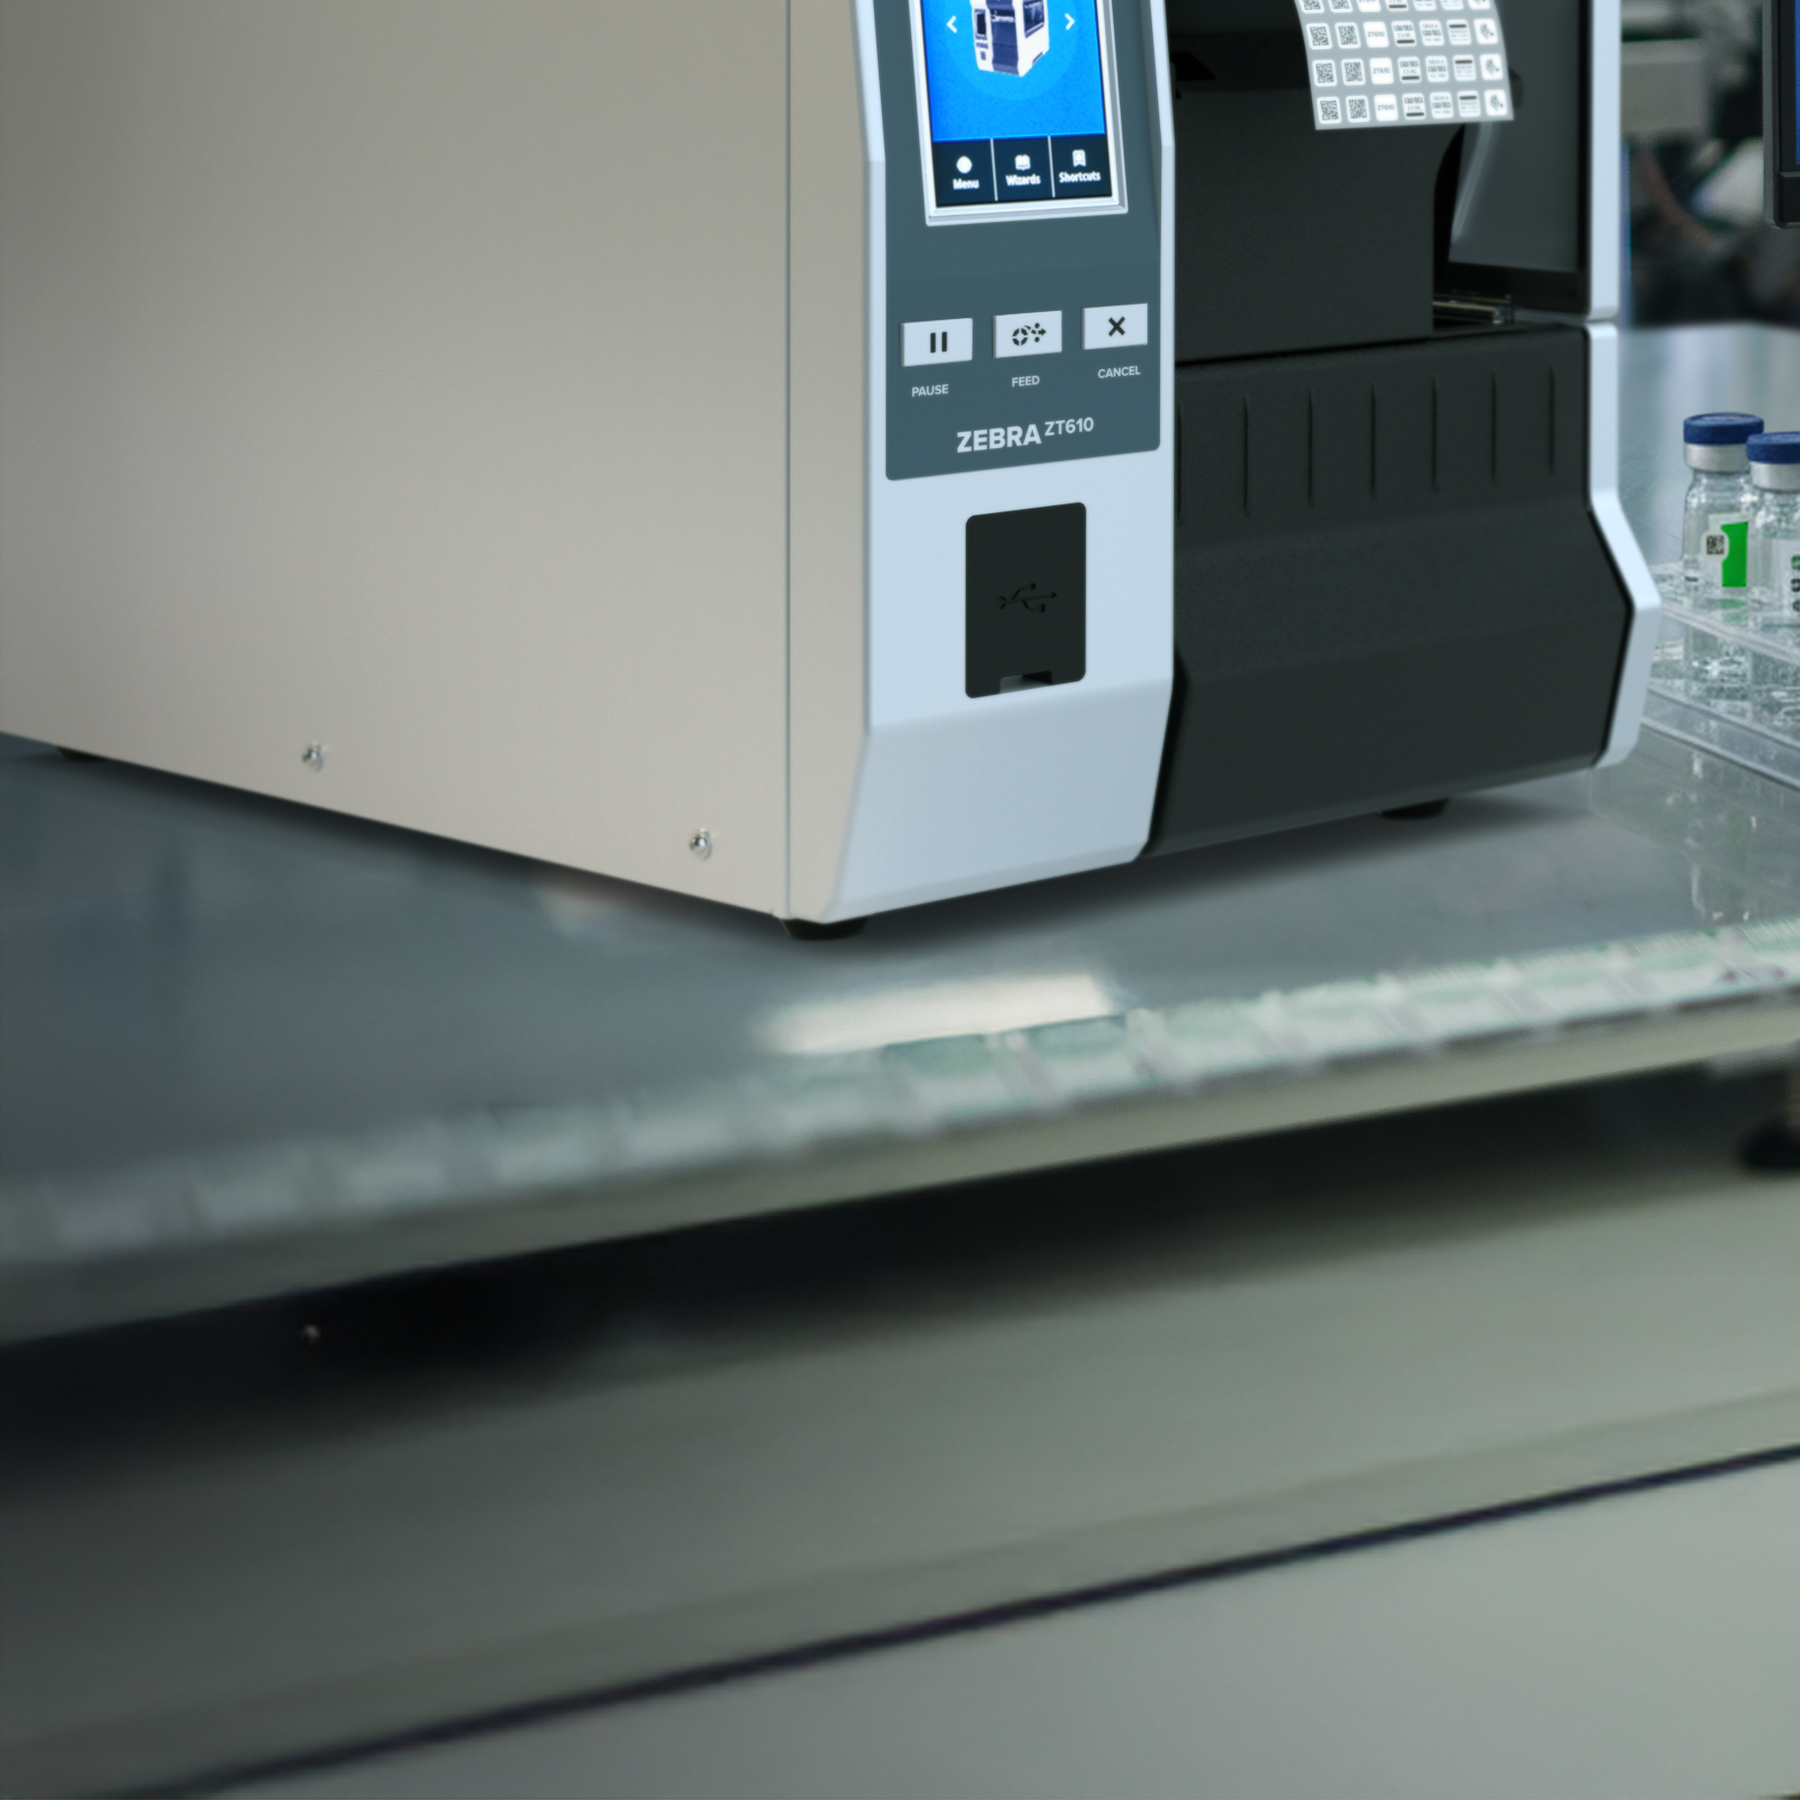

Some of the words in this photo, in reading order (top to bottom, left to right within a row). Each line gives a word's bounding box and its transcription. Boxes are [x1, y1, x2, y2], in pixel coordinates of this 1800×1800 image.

[952, 178, 980, 190] Menu
[1005, 173, 1042, 187] Wizards
[1058, 170, 1102, 184] Shortcuts
[1097, 365, 1141, 379] CANCEL
[1011, 374, 1041, 388] FEED
[911, 383, 949, 398] PAUSE
[956, 423, 1042, 454] ZEBRA
[1044, 416, 1095, 437] ZT610
